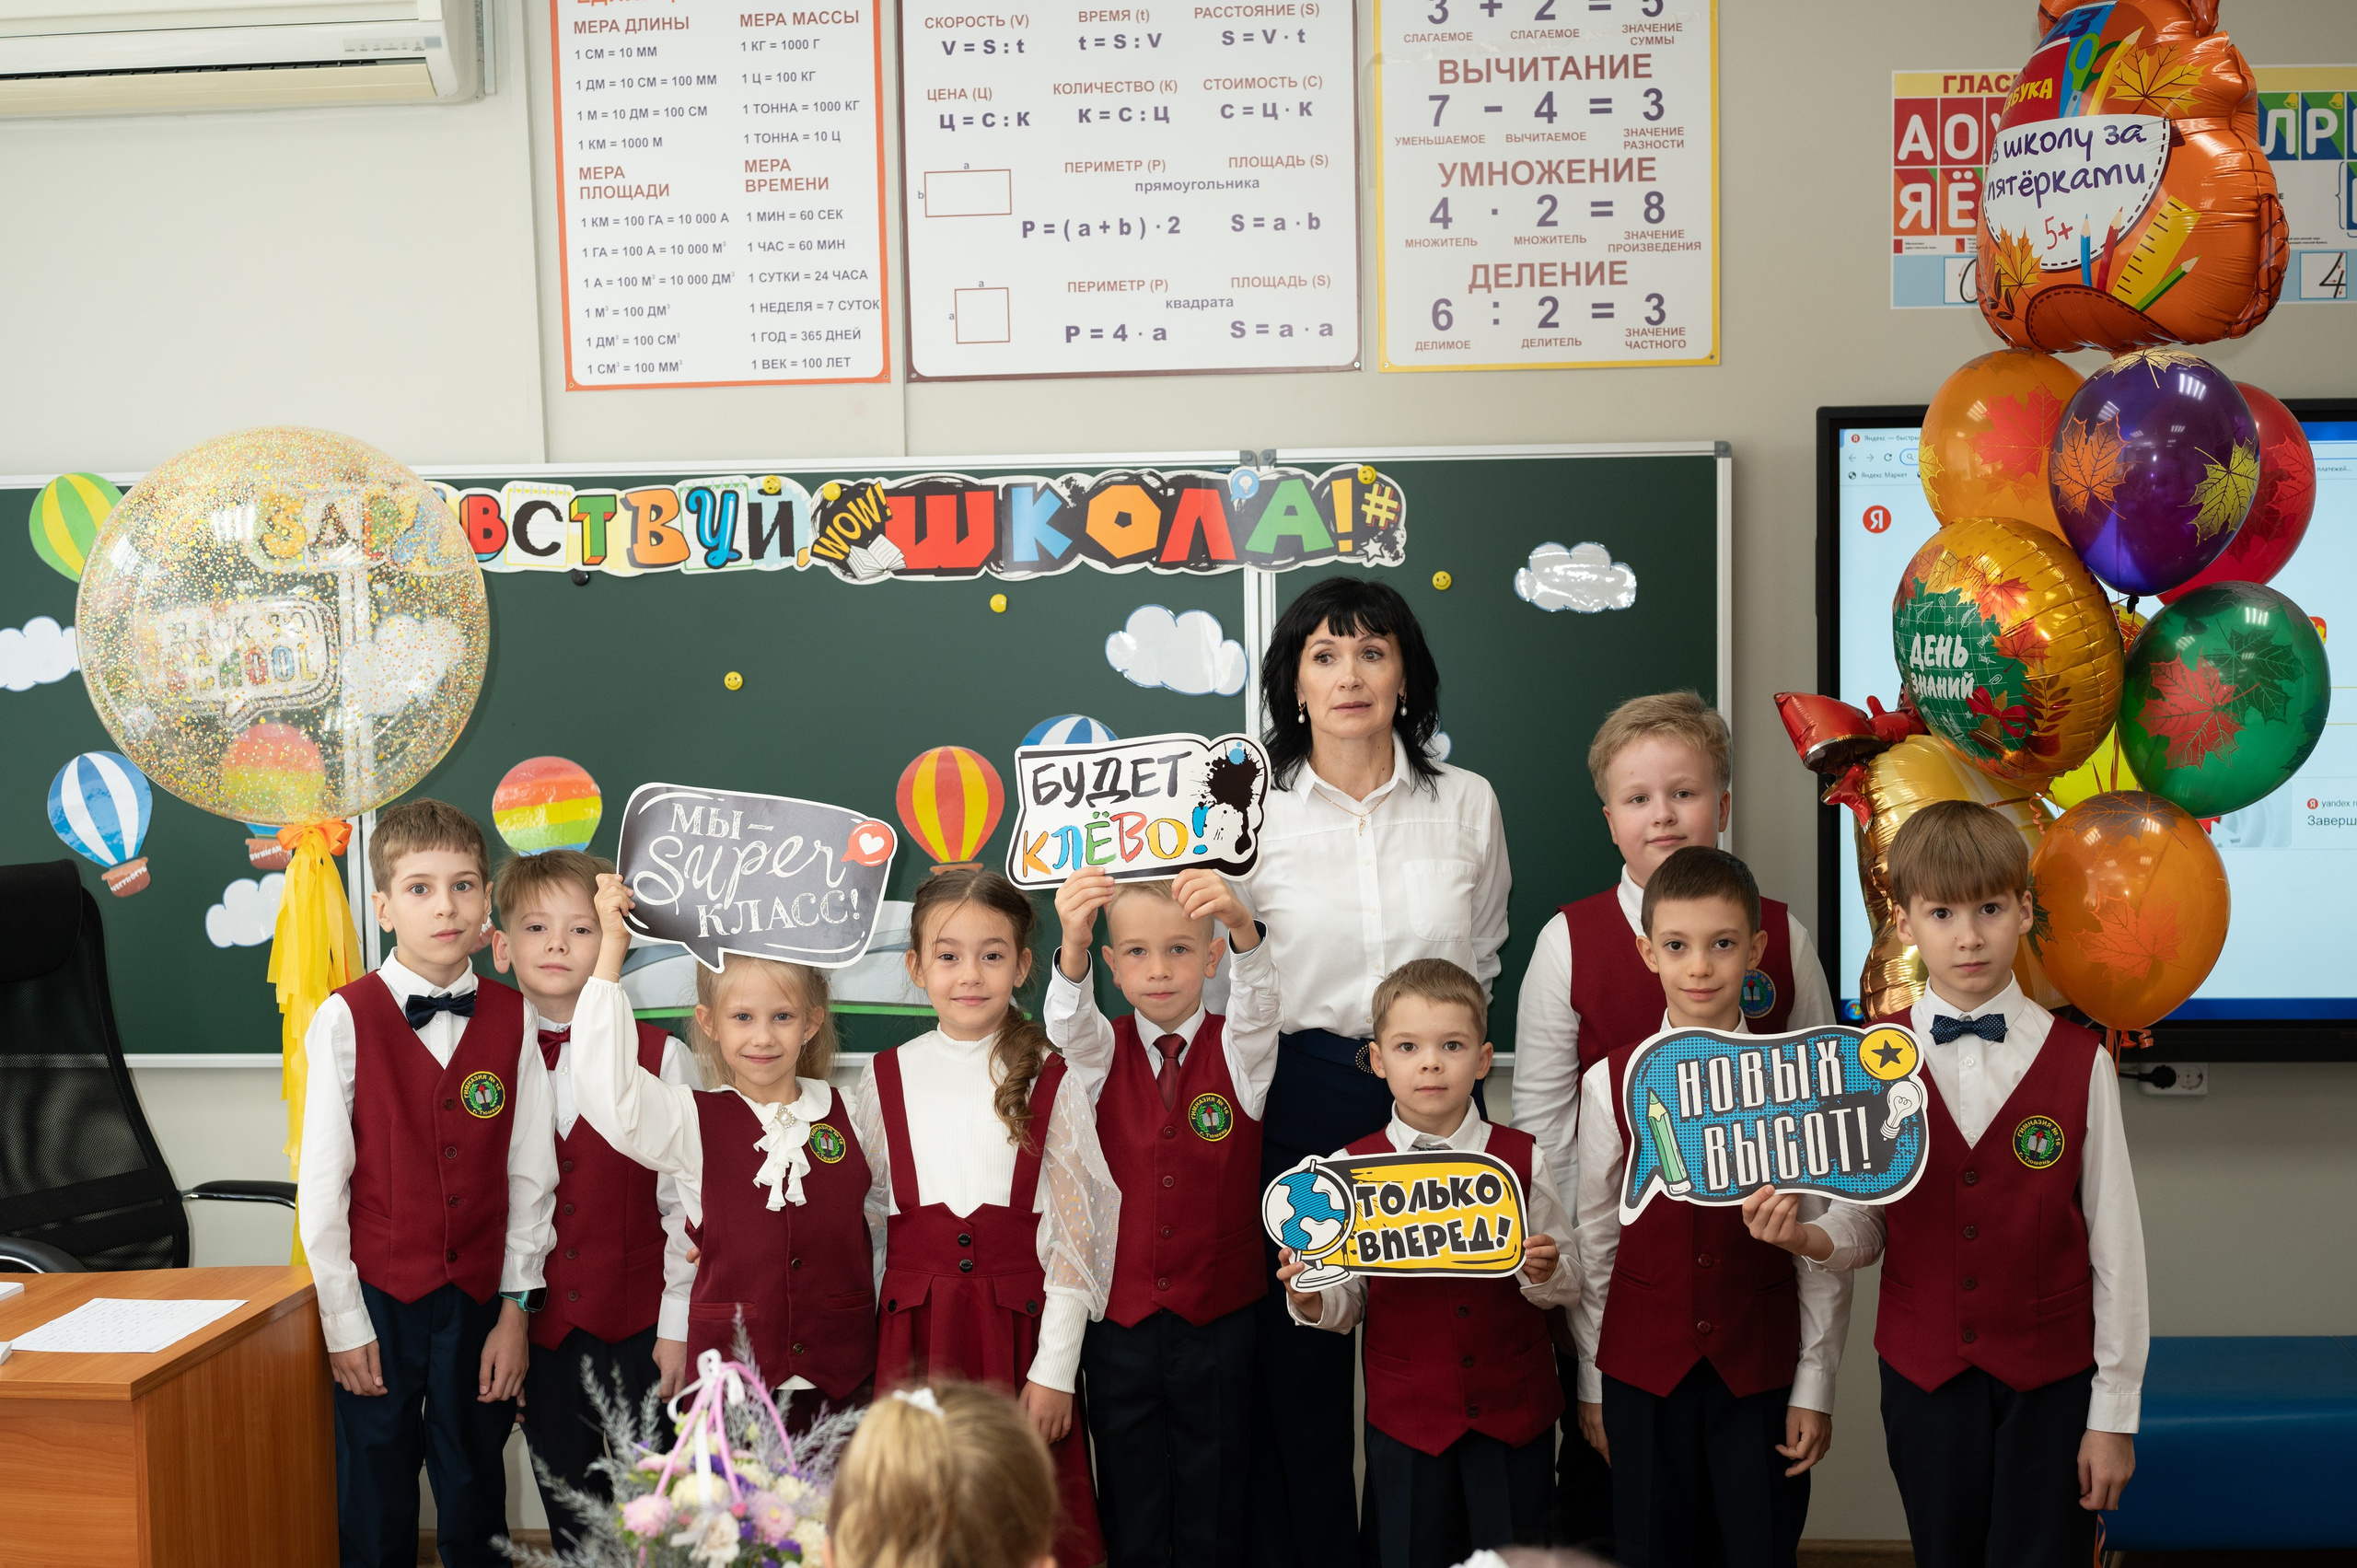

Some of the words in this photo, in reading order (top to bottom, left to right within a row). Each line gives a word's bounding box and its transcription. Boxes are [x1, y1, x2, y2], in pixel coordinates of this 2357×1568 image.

[1079, 10, 1130, 22] ВРЕМЯ
[1136, 9, 1149, 23] (t)
[1195, 5, 1295, 18] РАССТОЯНИЕ
[1301, 4, 1319, 17] (S)
[575, 19, 620, 34] МЕРА
[625, 17, 689, 34] ДЛИНЫ
[740, 13, 786, 27] МЕРА
[793, 10, 858, 25] МАССЫ
[925, 16, 1005, 29] СКОРОСТЬ
[1011, 15, 1028, 29] (V)
[1511, 29, 1580, 40] СЛАГАЕМОЕ
[1622, 23, 1682, 33] ЗНАЧЕНИЕ
[1404, 32, 1472, 42] СЛАГАЕМОЕ
[1631, 36, 1674, 45] СУММЫ
[1440, 53, 1652, 84] ВЫЧИТАНИЕ
[1053, 81, 1155, 95] КОЛИЧЕСТВО
[1203, 76, 1297, 90] СТОИМОСТЬ
[1943, 74, 2018, 94] ГЛАС
[928, 88, 968, 102] ЦЕНА
[973, 87, 992, 101] (Ц)
[1429, 95, 1449, 126] 7
[1535, 91, 1557, 123] 4
[1590, 99, 1612, 114] =
[1643, 88, 1664, 121] 3
[1506, 132, 1586, 143] ВЫЧИТАЕМОЕ
[1624, 127, 1684, 137] ЗНАЧЕНИЕ
[1395, 134, 1485, 145] УМЕНЬШАЕМОЕ
[1624, 140, 1684, 149] РАЗНОСТИ
[2003, 128, 2093, 161] школу
[2104, 124, 2146, 145] за
[745, 158, 791, 172] МЕРА
[1065, 160, 1143, 173] ПЕРИМЕТР
[1229, 156, 1306, 168] ПЛОЩАДЬ
[1310, 155, 1329, 168] (S)
[579, 166, 625, 180] МЕРА
[1438, 157, 1656, 187] УМНОЖЕНИЕ
[746, 177, 828, 192] ВРЕМЕНИ
[1135, 180, 1259, 194] прямоугольника
[1987, 164, 2145, 208] пятёрками
[580, 184, 668, 200] ПЛОЩАДИ
[1899, 183, 1931, 229] Я
[1948, 170, 1976, 227] Ё
[758, 212, 784, 221] МИН
[800, 210, 813, 220] 60
[819, 209, 842, 219] СЕК
[1430, 197, 1452, 229] 4
[1537, 194, 1558, 226] 2
[1591, 201, 1613, 216] =
[1644, 192, 1665, 224] 8
[1515, 235, 1586, 245] МНОЖИТЕЛЬ
[1624, 229, 1684, 239] ЗНАЧЕНИЕ
[2045, 216, 2073, 250] 5+
[758, 241, 784, 251] ЧАС
[799, 240, 812, 250] 60
[818, 239, 844, 250] МИН
[1406, 238, 1478, 248] МНОЖИТЕЛЬ
[1608, 242, 1701, 252] ПРОИЗВЕДЕНИЯ
[760, 272, 799, 283] СУТКИ
[815, 271, 829, 281] 24
[833, 270, 867, 280] ЧАСА
[1231, 276, 1307, 289] ПЛОЩАДЬ
[1313, 275, 1330, 288] (S)
[1469, 261, 1628, 294] ДЕЛЕНИЕ
[1068, 280, 1144, 292] ПЕРИМЕТР
[761, 302, 812, 314] НЕДЕЛЯ
[839, 300, 879, 310] СУТОК
[1167, 298, 1233, 310] квадрата
[1432, 298, 1453, 331] 6
[1538, 296, 1559, 328] 2
[1592, 303, 1614, 319] =
[1645, 293, 1666, 326] 3
[761, 331, 786, 343] ГОД
[802, 331, 821, 341] 365
[826, 328, 860, 342] ДНЕЙ
[1626, 327, 1685, 337] ЗНАЧЕНИЕ
[1415, 341, 1470, 351] ДЕЛИМОЕ
[1522, 338, 1582, 349] ДЕЛИТЕЛЬ
[1625, 340, 1686, 349] ЧАСТНОГО
[762, 359, 786, 369] ВЕК
[802, 358, 822, 367] 100
[827, 357, 851, 367] ЛЕТ
[812, 482, 894, 563] WOW!
[885, 477, 1353, 569] ШКОЛА!
[1910, 633, 1968, 672] ДЕНЬ
[1910, 671, 1974, 700] ЗНАНИЙ
[1032, 751, 1191, 808] БУДЕТ
[1023, 806, 1210, 877] КЛЁВО!
[633, 835, 847, 915] Super
[696, 889, 860, 937] КЛАСС!
[464, 1074, 486, 1098] ГИМНАЗИЯ
[1678, 1040, 1841, 1118] НОВЫХ
[1190, 1097, 1215, 1120] ГИМНАЗИЯ
[2017, 1120, 2051, 1137] ГИМНАЗИЯ
[1704, 1106, 1871, 1191] ВЫСОТ!
[1354, 1171, 1504, 1220] ТОЛЬКО
[1357, 1214, 1514, 1264] ВПЕРЕД!
